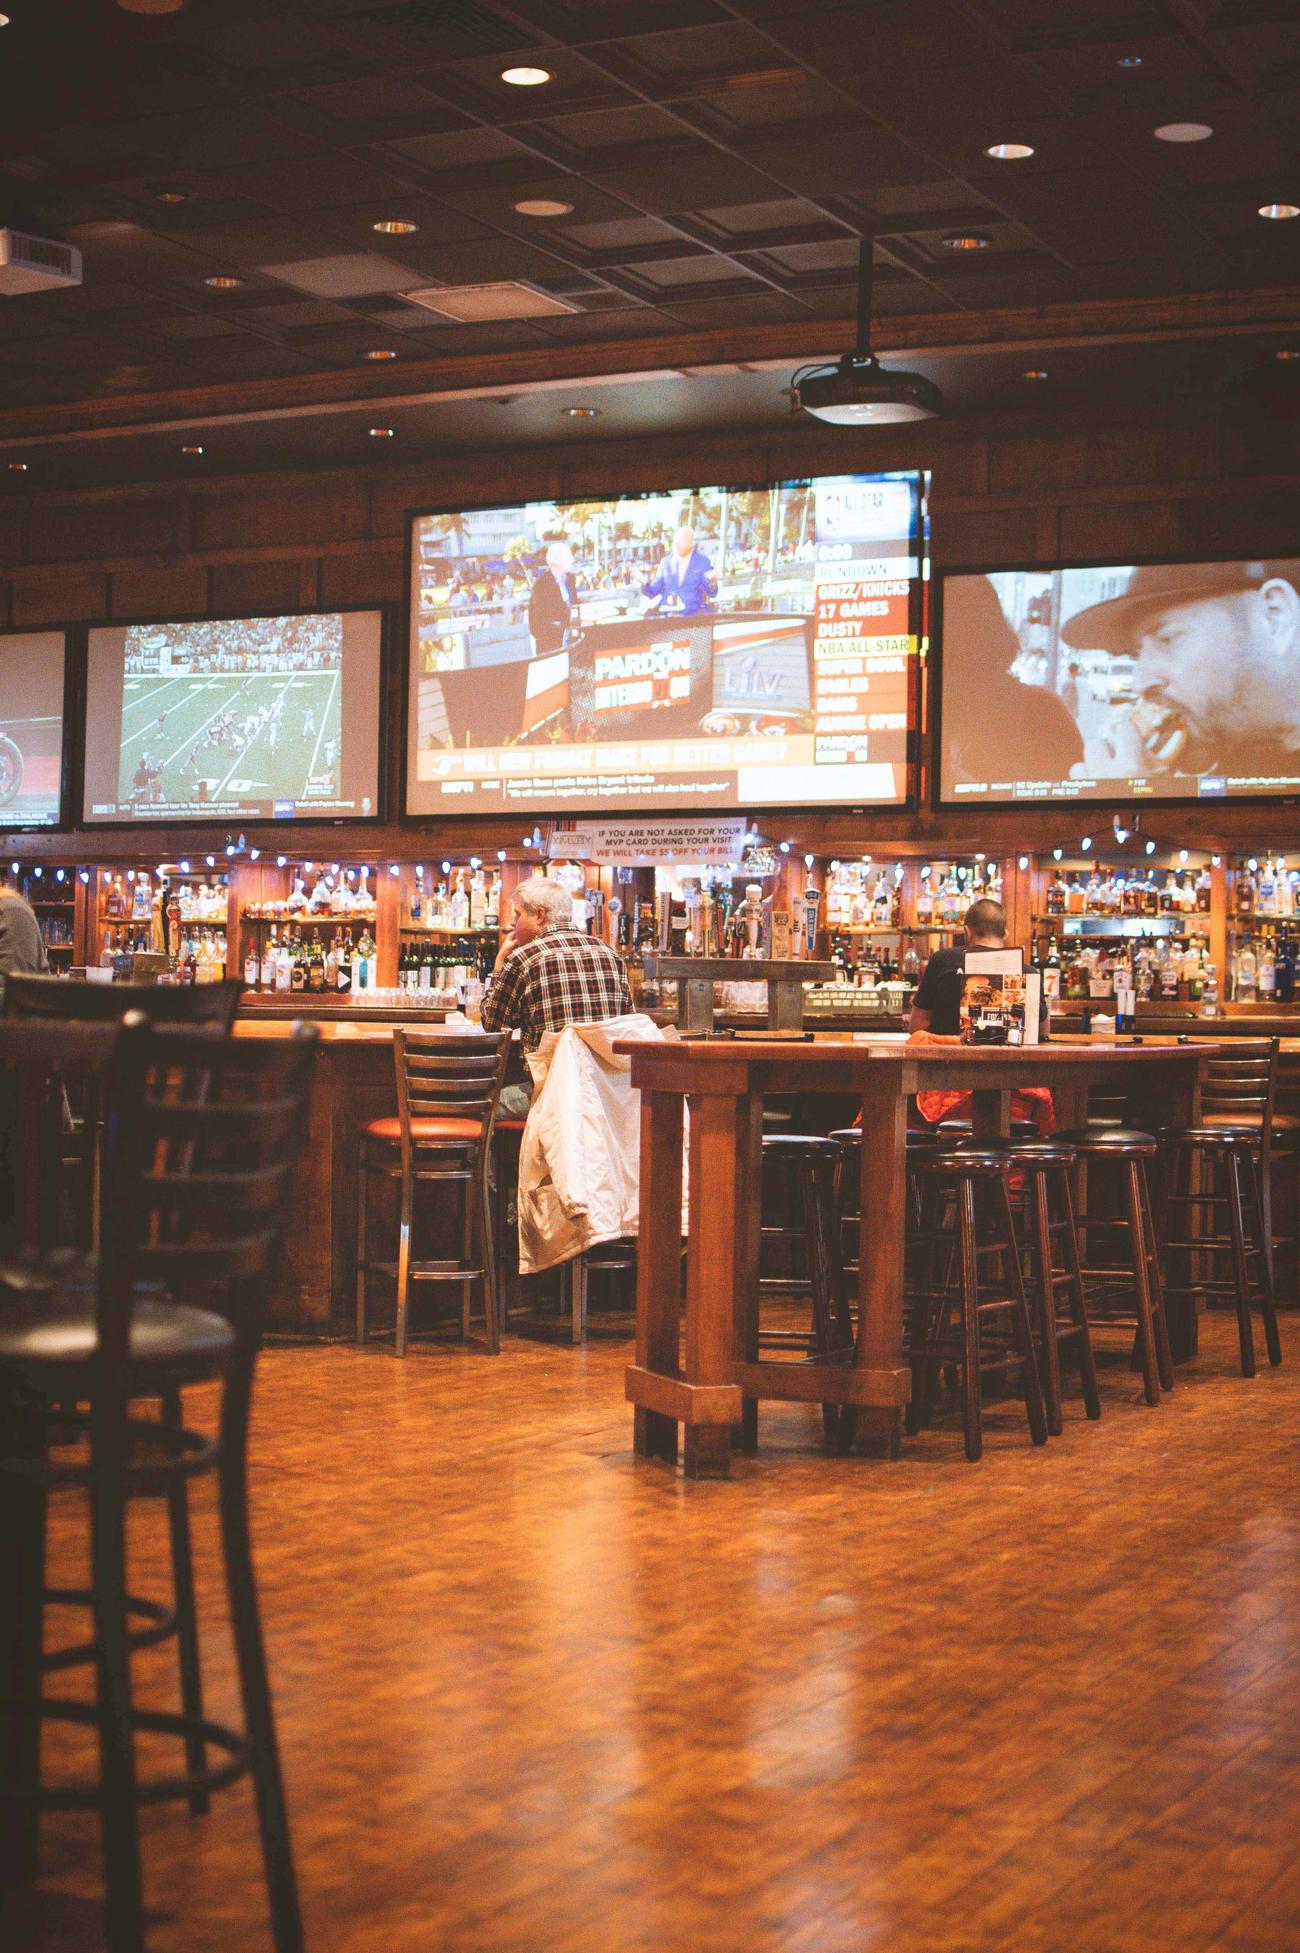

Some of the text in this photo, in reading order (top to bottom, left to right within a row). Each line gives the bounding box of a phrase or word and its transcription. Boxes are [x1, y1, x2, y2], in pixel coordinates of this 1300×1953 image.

[820, 563, 888, 577] RUNDOWN
[818, 580, 910, 600] GRIZZ/KNICKS
[818, 600, 890, 619] 17 GAMES
[818, 621, 864, 638] DUSTY
[818, 638, 910, 656] NBA ALL STAR
[595, 647, 691, 681] PARDON
[628, 829, 645, 837] ARE
[668, 828, 696, 836] ASKED
[697, 827, 715, 835] FOR
[717, 827, 740, 835] YOUR
[605, 838, 624, 846] MVP
[626, 838, 649, 846] CARD
[651, 837, 684, 845] DURING
[712, 836, 731, 844] VISIT
[596, 849, 610, 857] WE
[660, 848, 669, 856] $5
[672, 847, 689, 855] OFF
[691, 846, 715, 855] YOUR
[1045, 975, 1057, 993] 7
